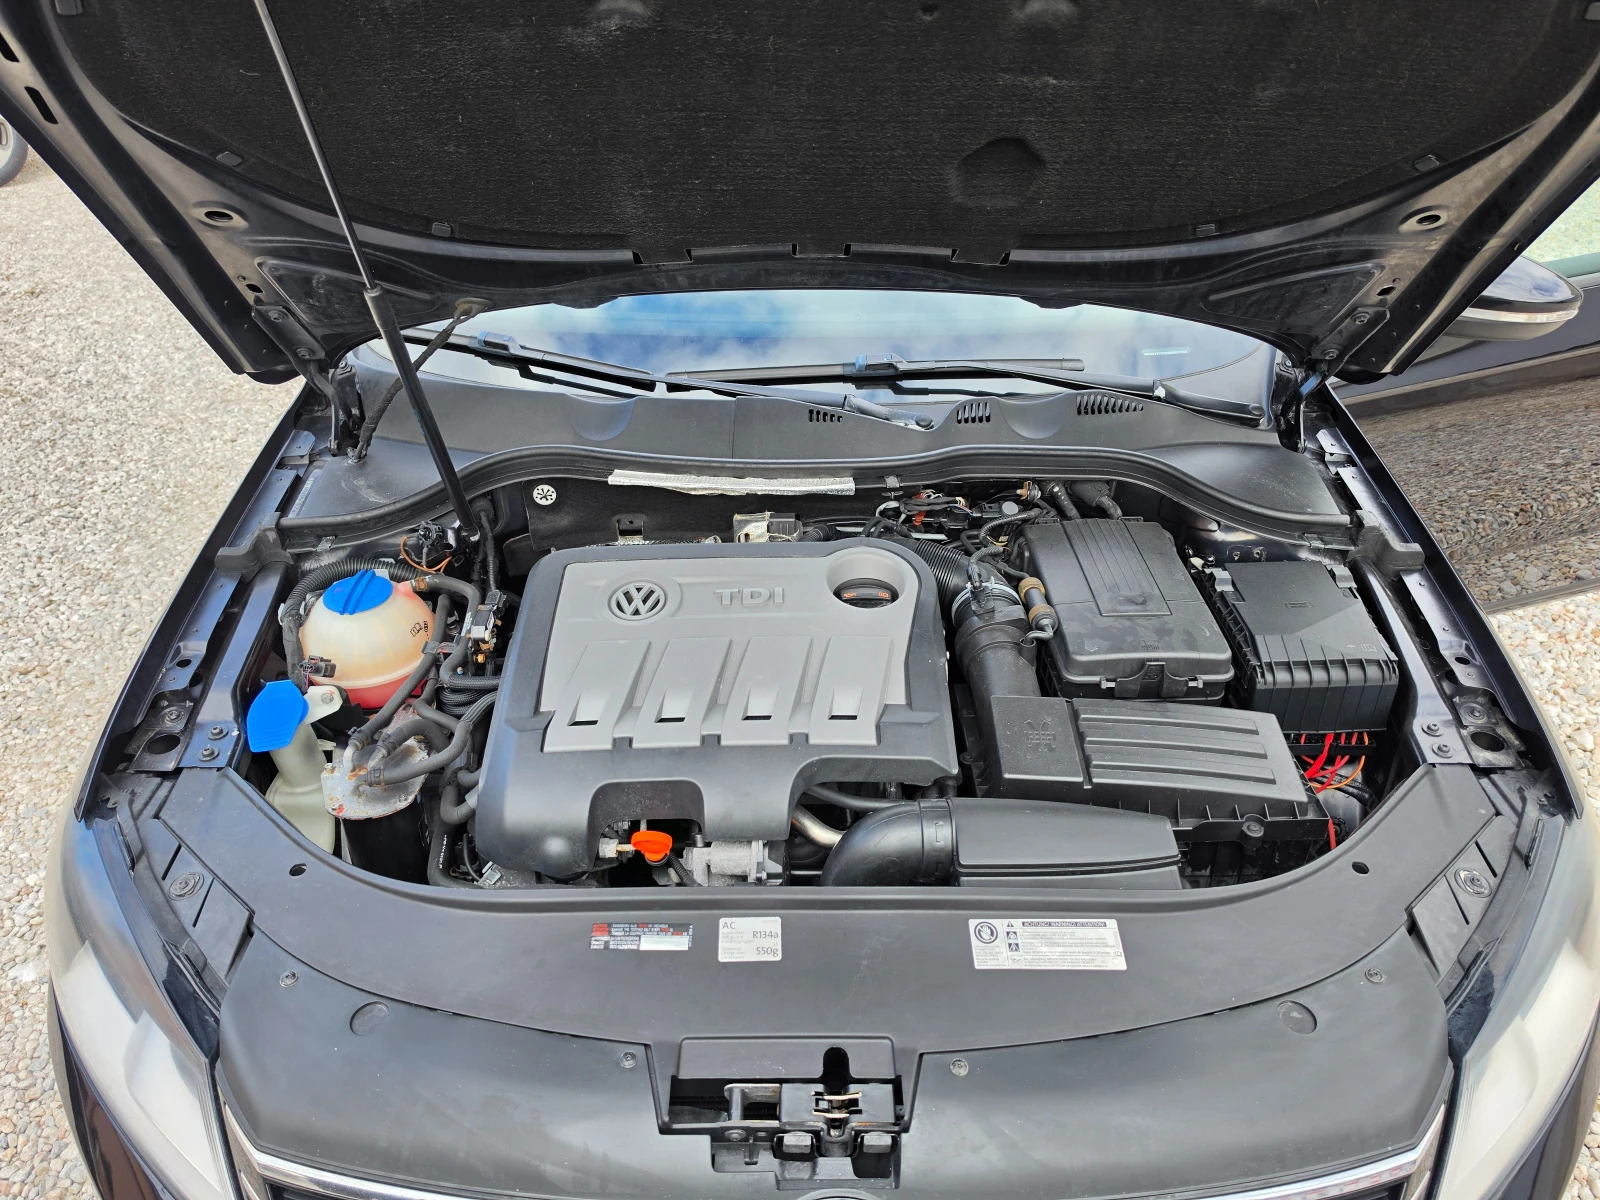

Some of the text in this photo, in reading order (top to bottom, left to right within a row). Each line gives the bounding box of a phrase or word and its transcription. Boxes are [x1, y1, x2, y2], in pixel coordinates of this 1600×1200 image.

[714, 587, 785, 607] TDI
[722, 921, 736, 930] AC
[752, 930, 779, 939] R134a
[756, 946, 779, 958] 550g
